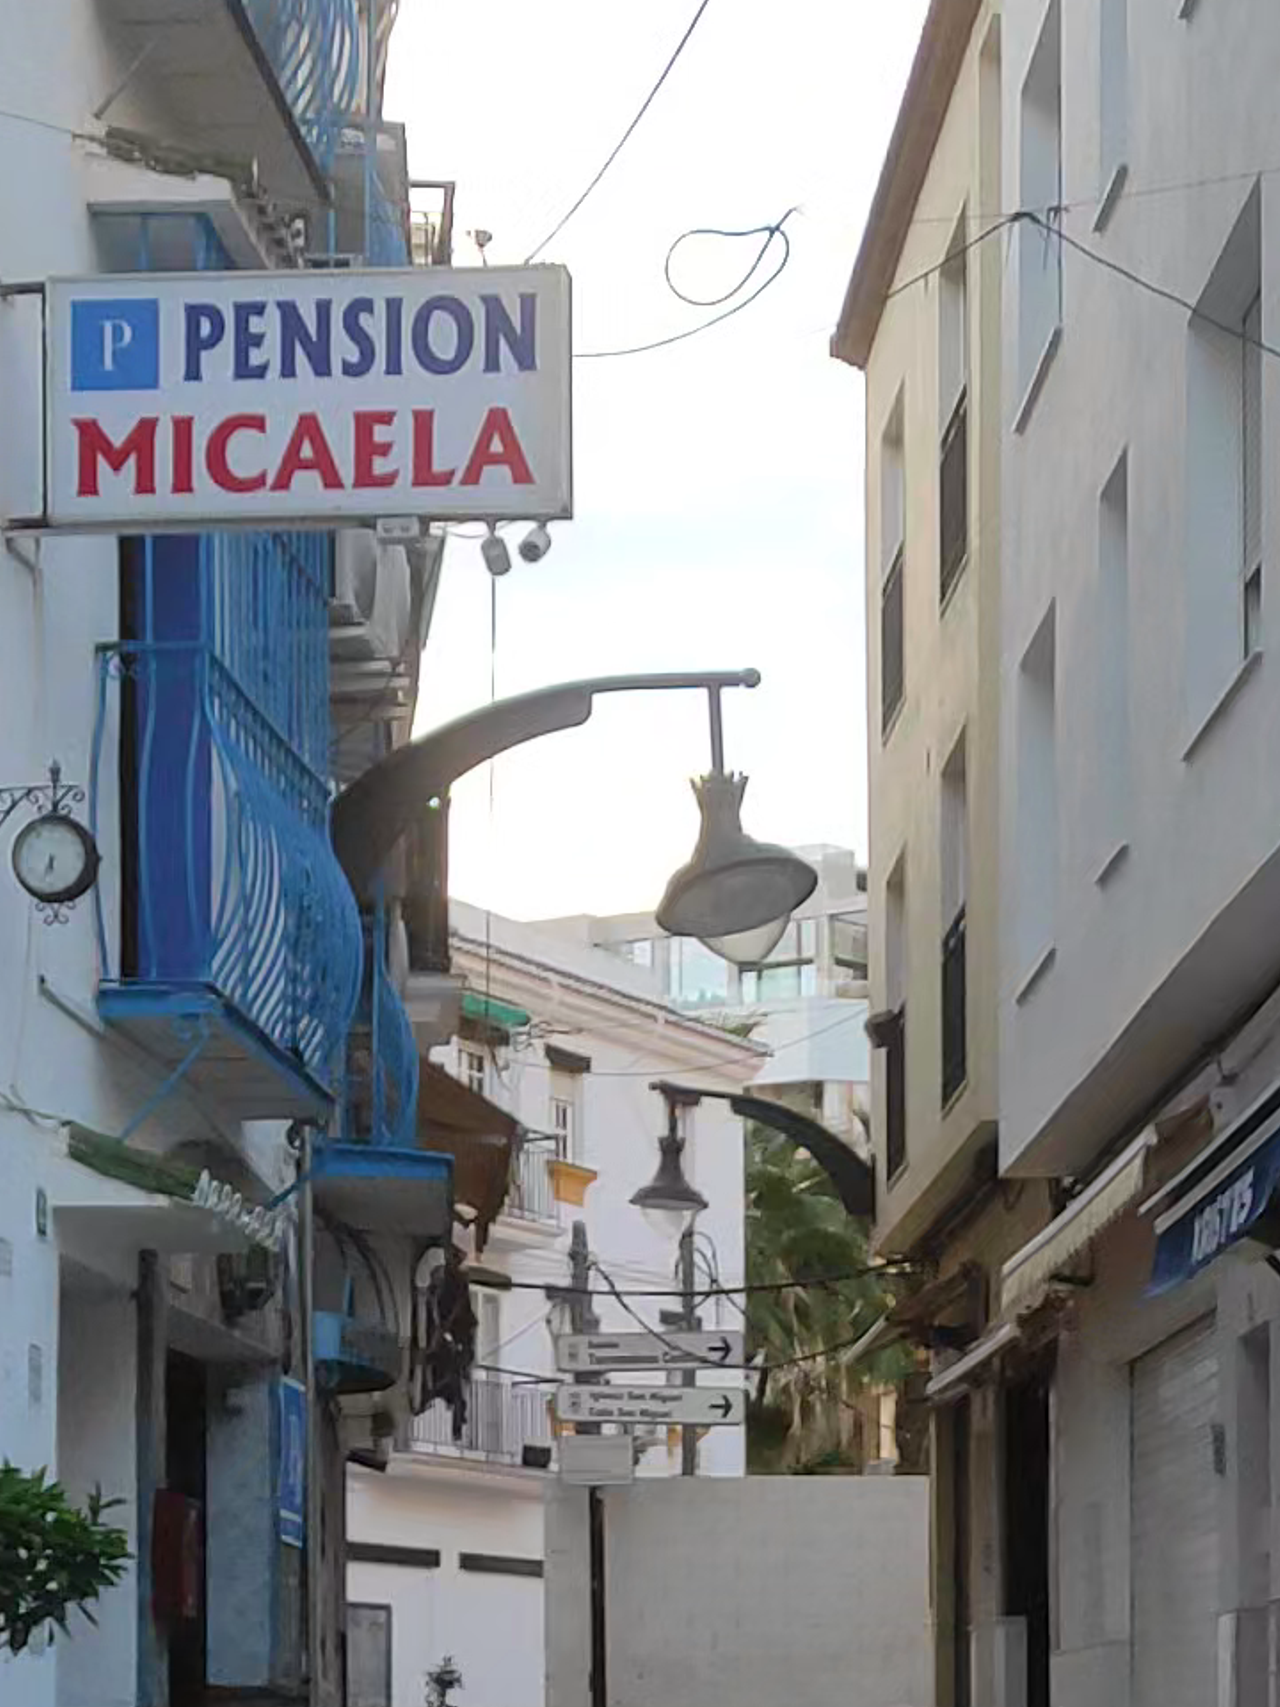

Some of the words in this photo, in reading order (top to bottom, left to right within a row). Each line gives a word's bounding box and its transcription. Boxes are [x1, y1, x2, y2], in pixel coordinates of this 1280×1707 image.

[99, 319, 132, 372] P
[182, 292, 539, 382] PENSION
[70, 406, 536, 498] MICAELA
